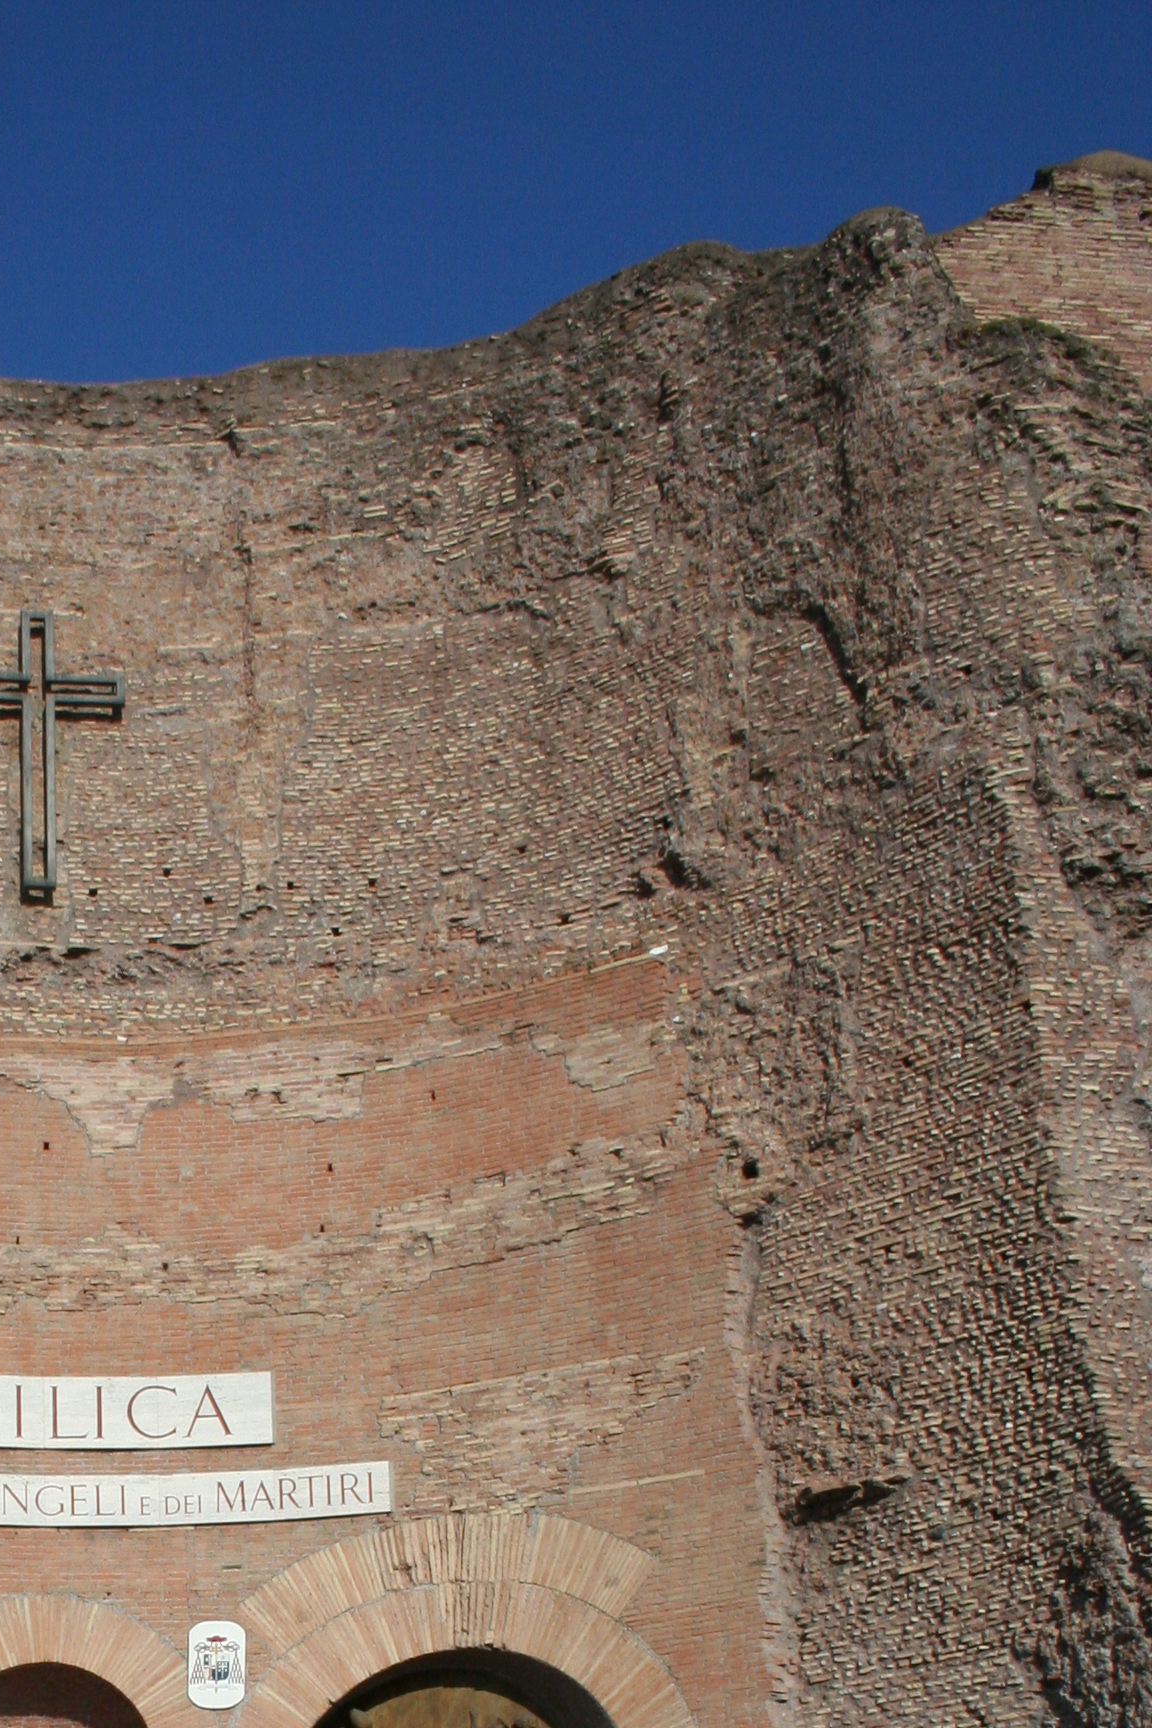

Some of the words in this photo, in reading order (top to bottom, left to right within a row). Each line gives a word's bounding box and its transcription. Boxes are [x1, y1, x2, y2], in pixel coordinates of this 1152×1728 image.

[139, 1496, 152, 1517] E
[164, 1494, 202, 1516] DEI
[215, 1471, 377, 1514] MARTIRI
